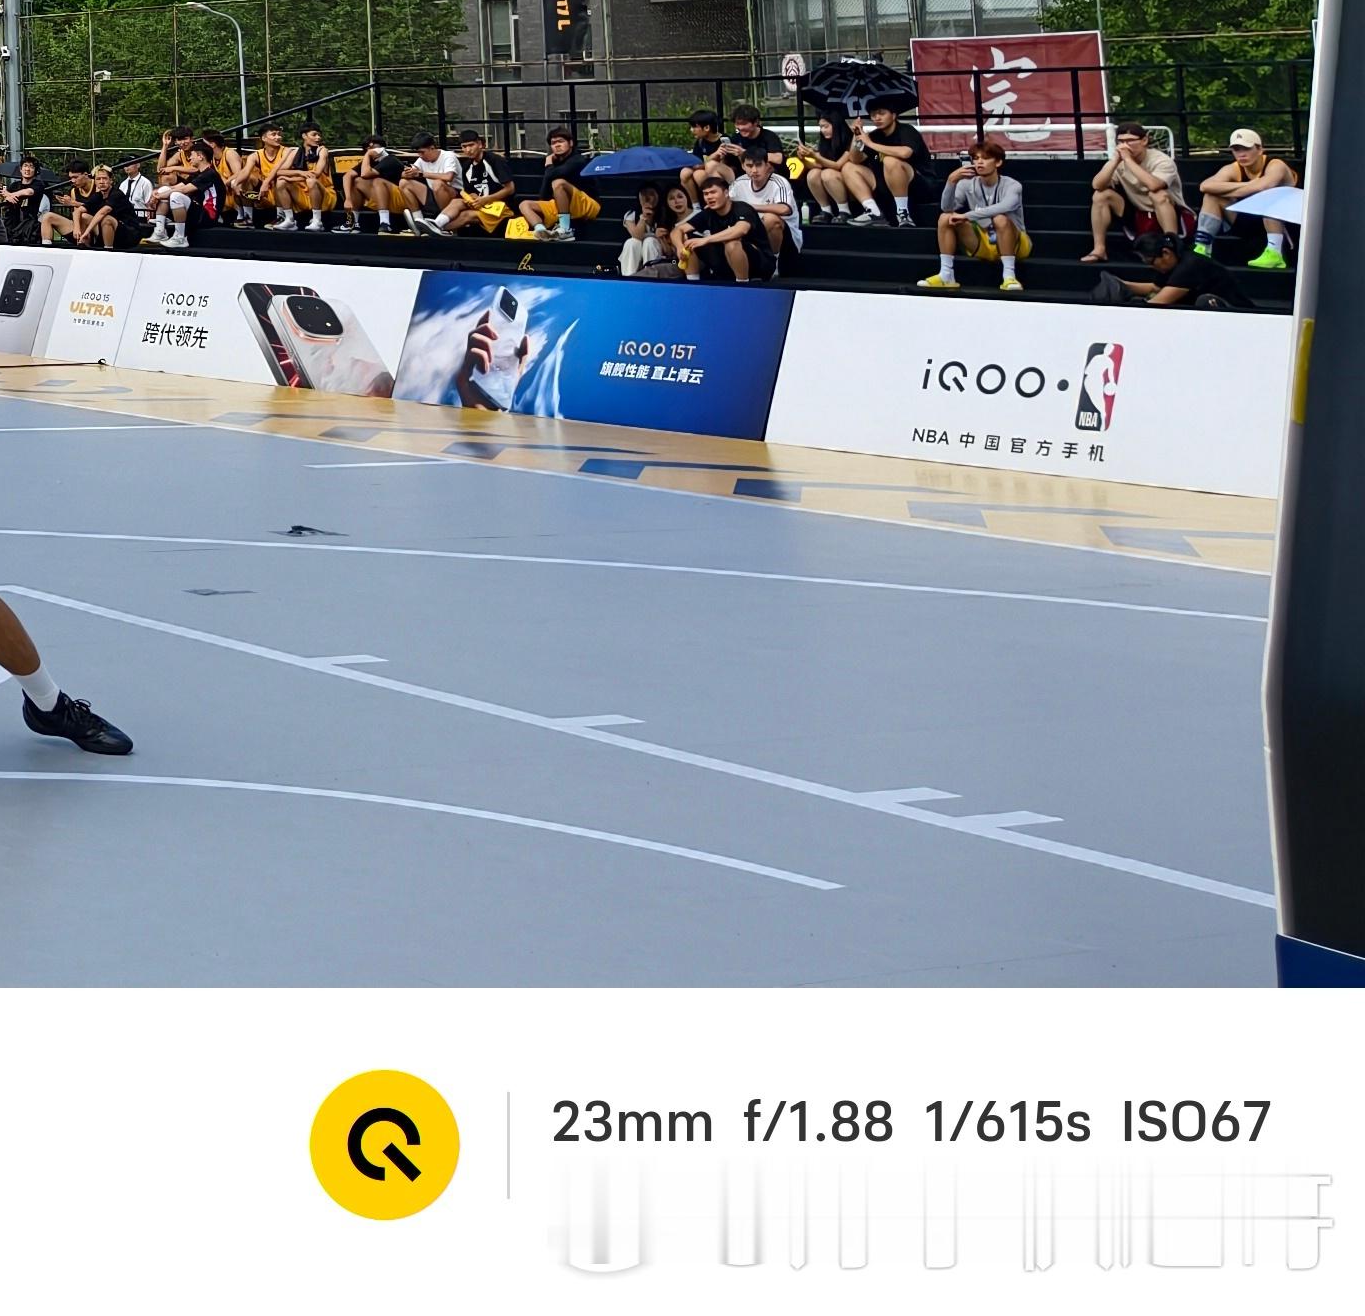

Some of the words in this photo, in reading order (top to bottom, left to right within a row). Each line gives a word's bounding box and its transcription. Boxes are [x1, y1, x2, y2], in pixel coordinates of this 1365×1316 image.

[69, 300, 115, 318] ULTRA
[161, 292, 195, 308] iQOO
[198, 294, 210, 308] 15
[141, 321, 210, 350] 跨代领先
[617, 339, 667, 358] iQOO
[670, 343, 698, 361] 15T
[599, 360, 651, 380] 旗舰性能
[650, 365, 705, 385] 直上青云
[921, 358, 1046, 399] iQOO
[1078, 411, 1099, 428] NBA
[912, 427, 950, 445] NBA
[959, 432, 1106, 462] 中国官方手机
